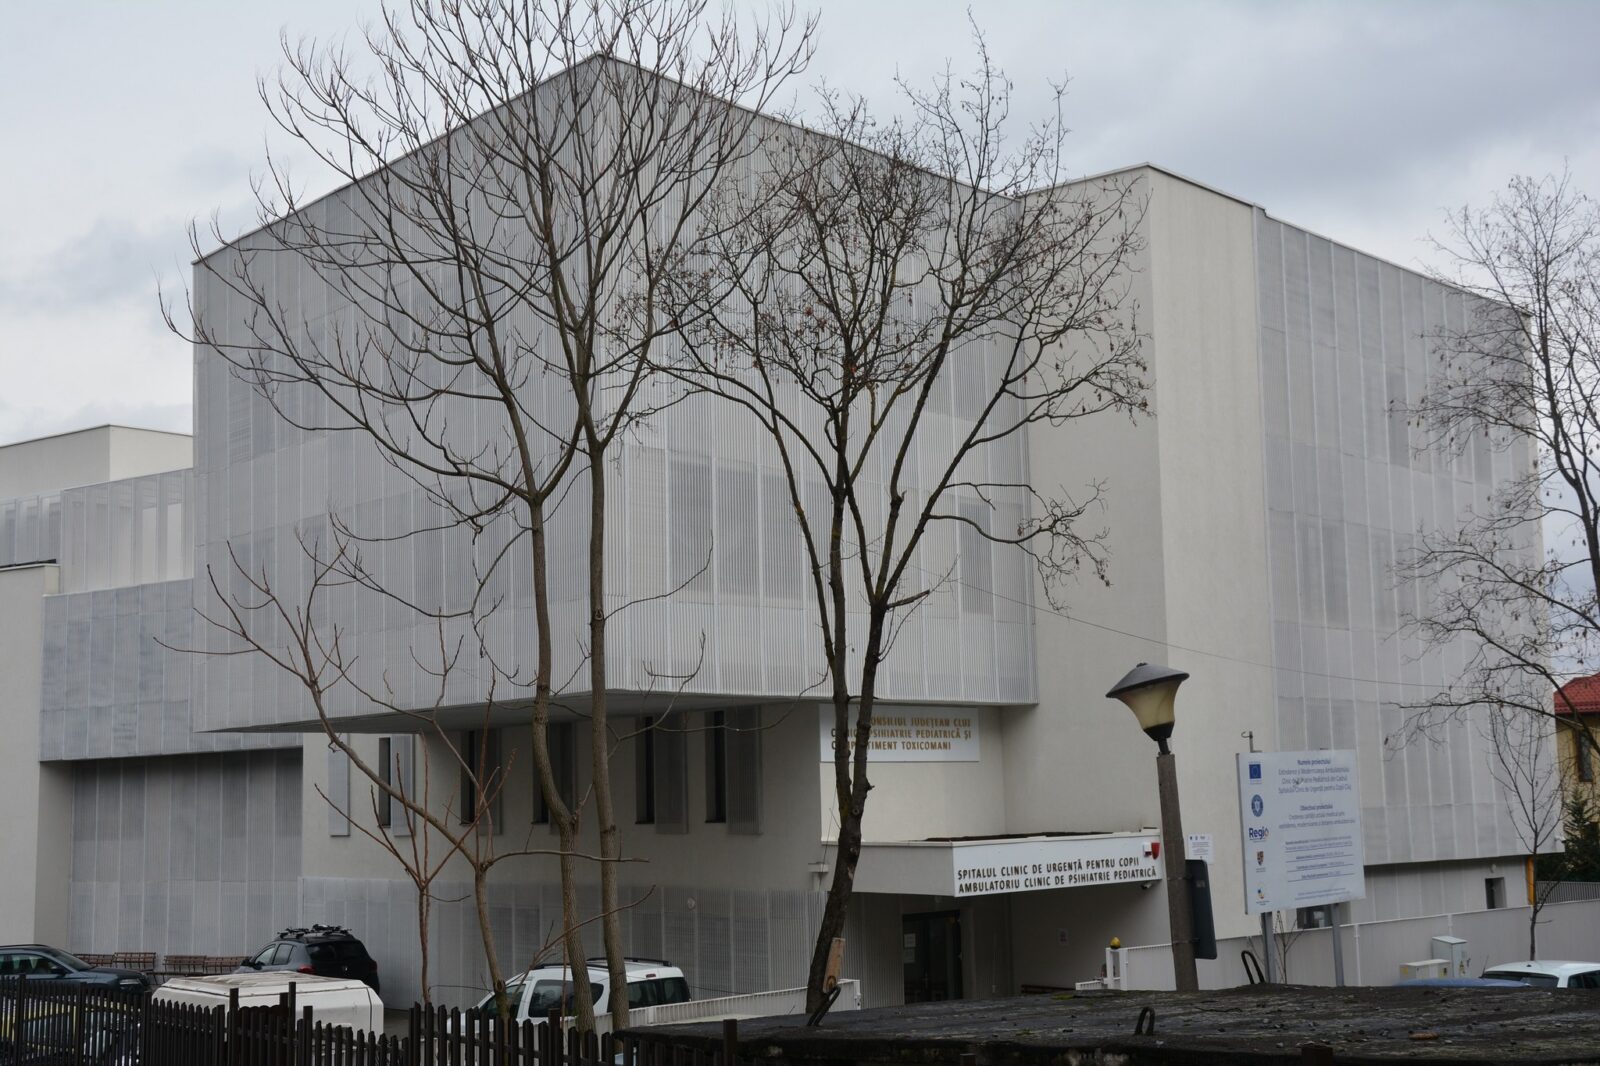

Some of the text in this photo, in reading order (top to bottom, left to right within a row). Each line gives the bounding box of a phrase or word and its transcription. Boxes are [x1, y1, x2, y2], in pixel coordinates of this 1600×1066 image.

[869, 715, 907, 727] ONSILIUL
[953, 717, 971, 727] CLUJ
[916, 727, 961, 738] PEDIATRICĂ
[902, 741, 951, 750] TOXICOMANI
[1248, 826, 1269, 839] Regio
[957, 857, 1139, 880] SPITALUL CLINIC DE URGENȚĂ PENTRU COPII
[958, 866, 1157, 893] AMBULATORIU CLINIC DE PSIHIATRIE PEDIATRICĂ
